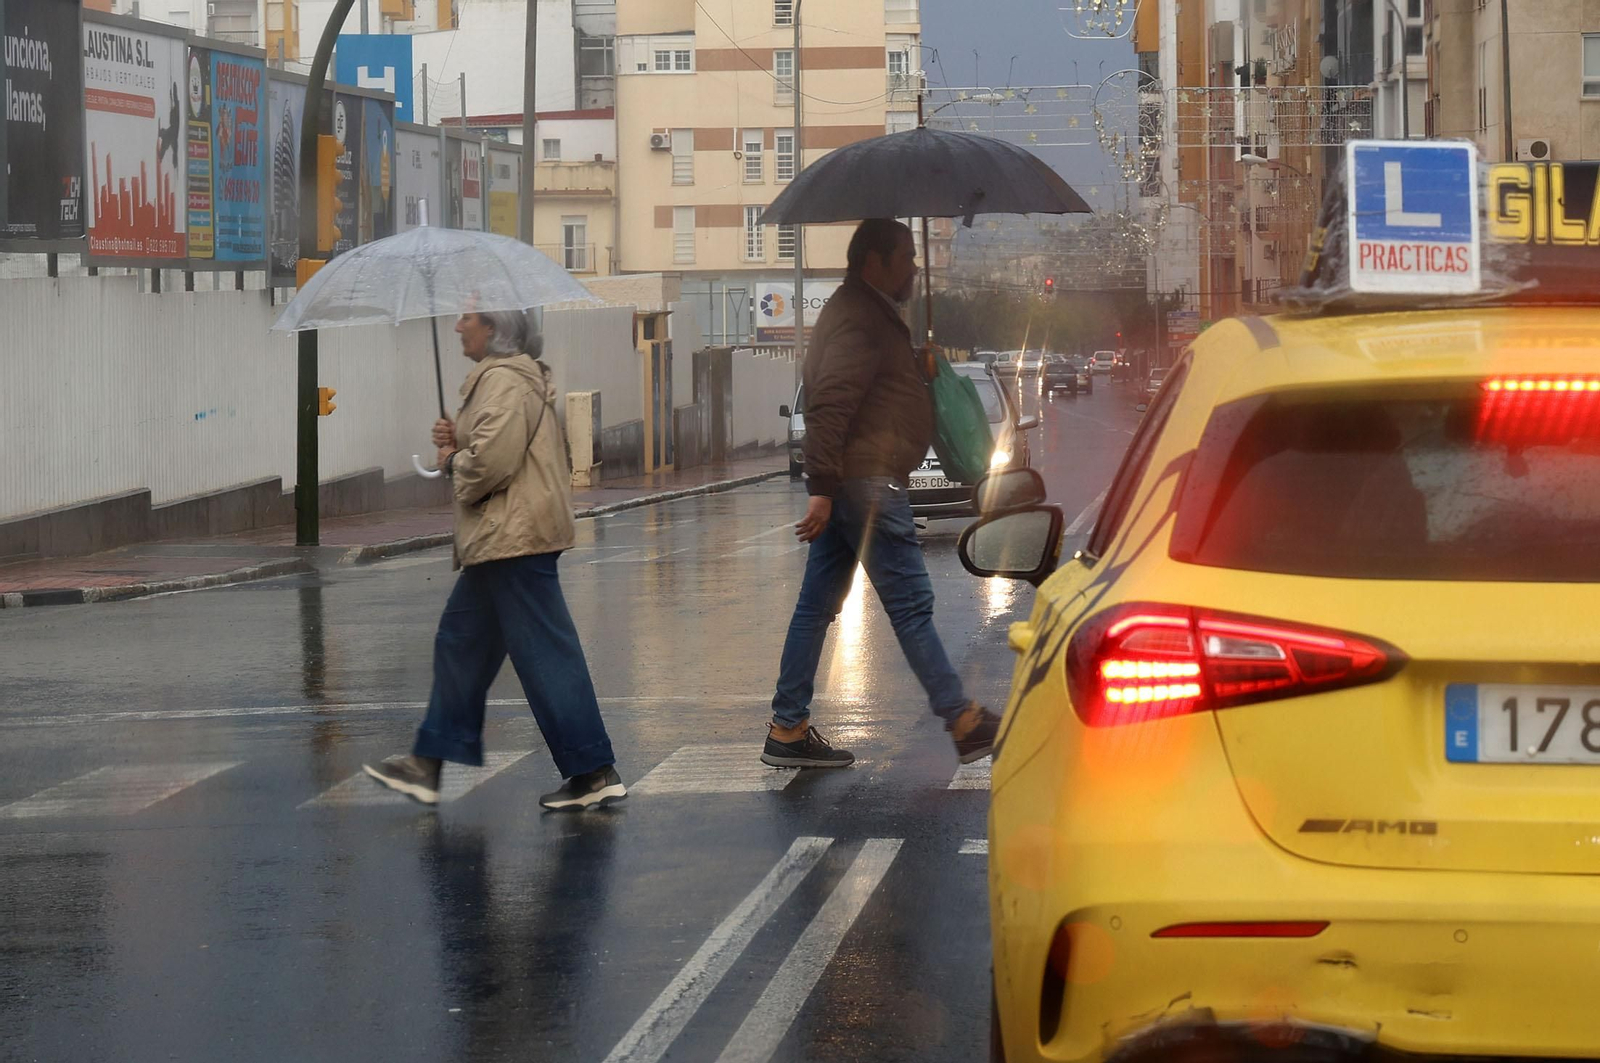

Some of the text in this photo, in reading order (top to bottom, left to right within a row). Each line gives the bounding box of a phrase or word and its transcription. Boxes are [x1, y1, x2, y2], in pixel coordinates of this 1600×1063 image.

[135, 39, 155, 69] S.L.
[5, 78, 47, 132] llamas,
[1384, 161, 1442, 228] L
[1358, 243, 1469, 274] PRACTICAS
[930, 477, 950, 488] CDS
[1455, 730, 1468, 747] E
